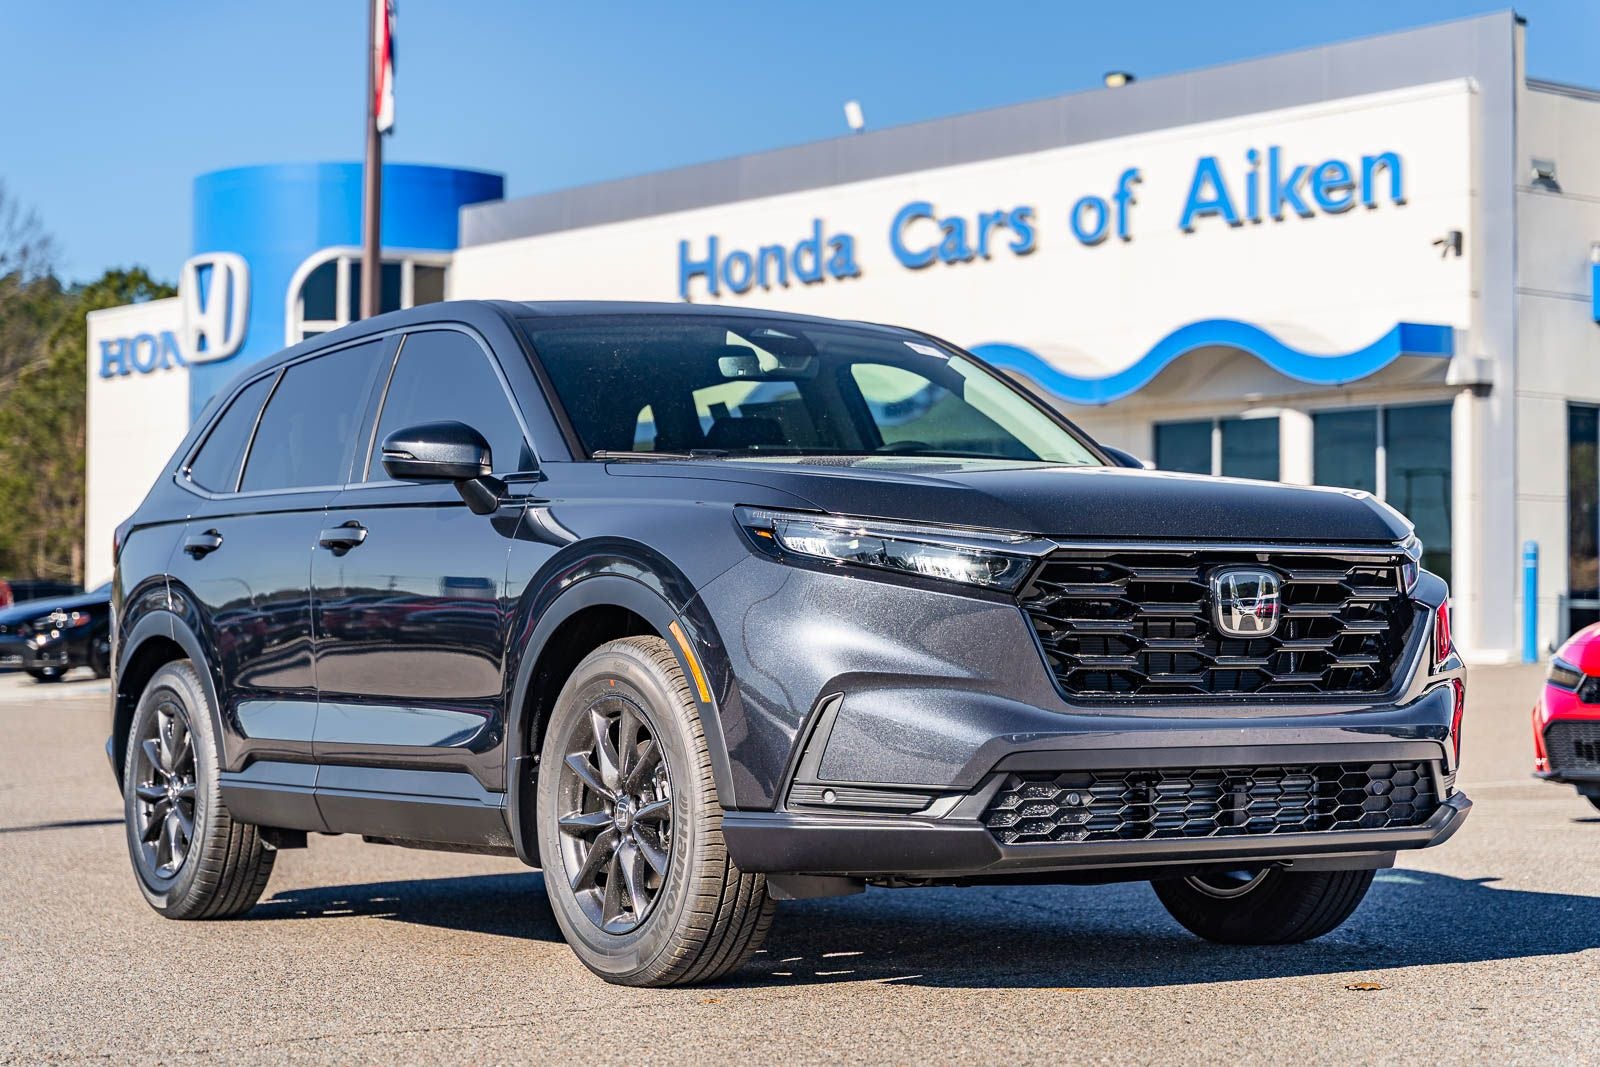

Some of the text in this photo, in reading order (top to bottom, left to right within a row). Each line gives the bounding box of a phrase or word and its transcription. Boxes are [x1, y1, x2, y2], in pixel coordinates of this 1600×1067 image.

[678, 145, 1407, 303] Honda Cars of Aiken
